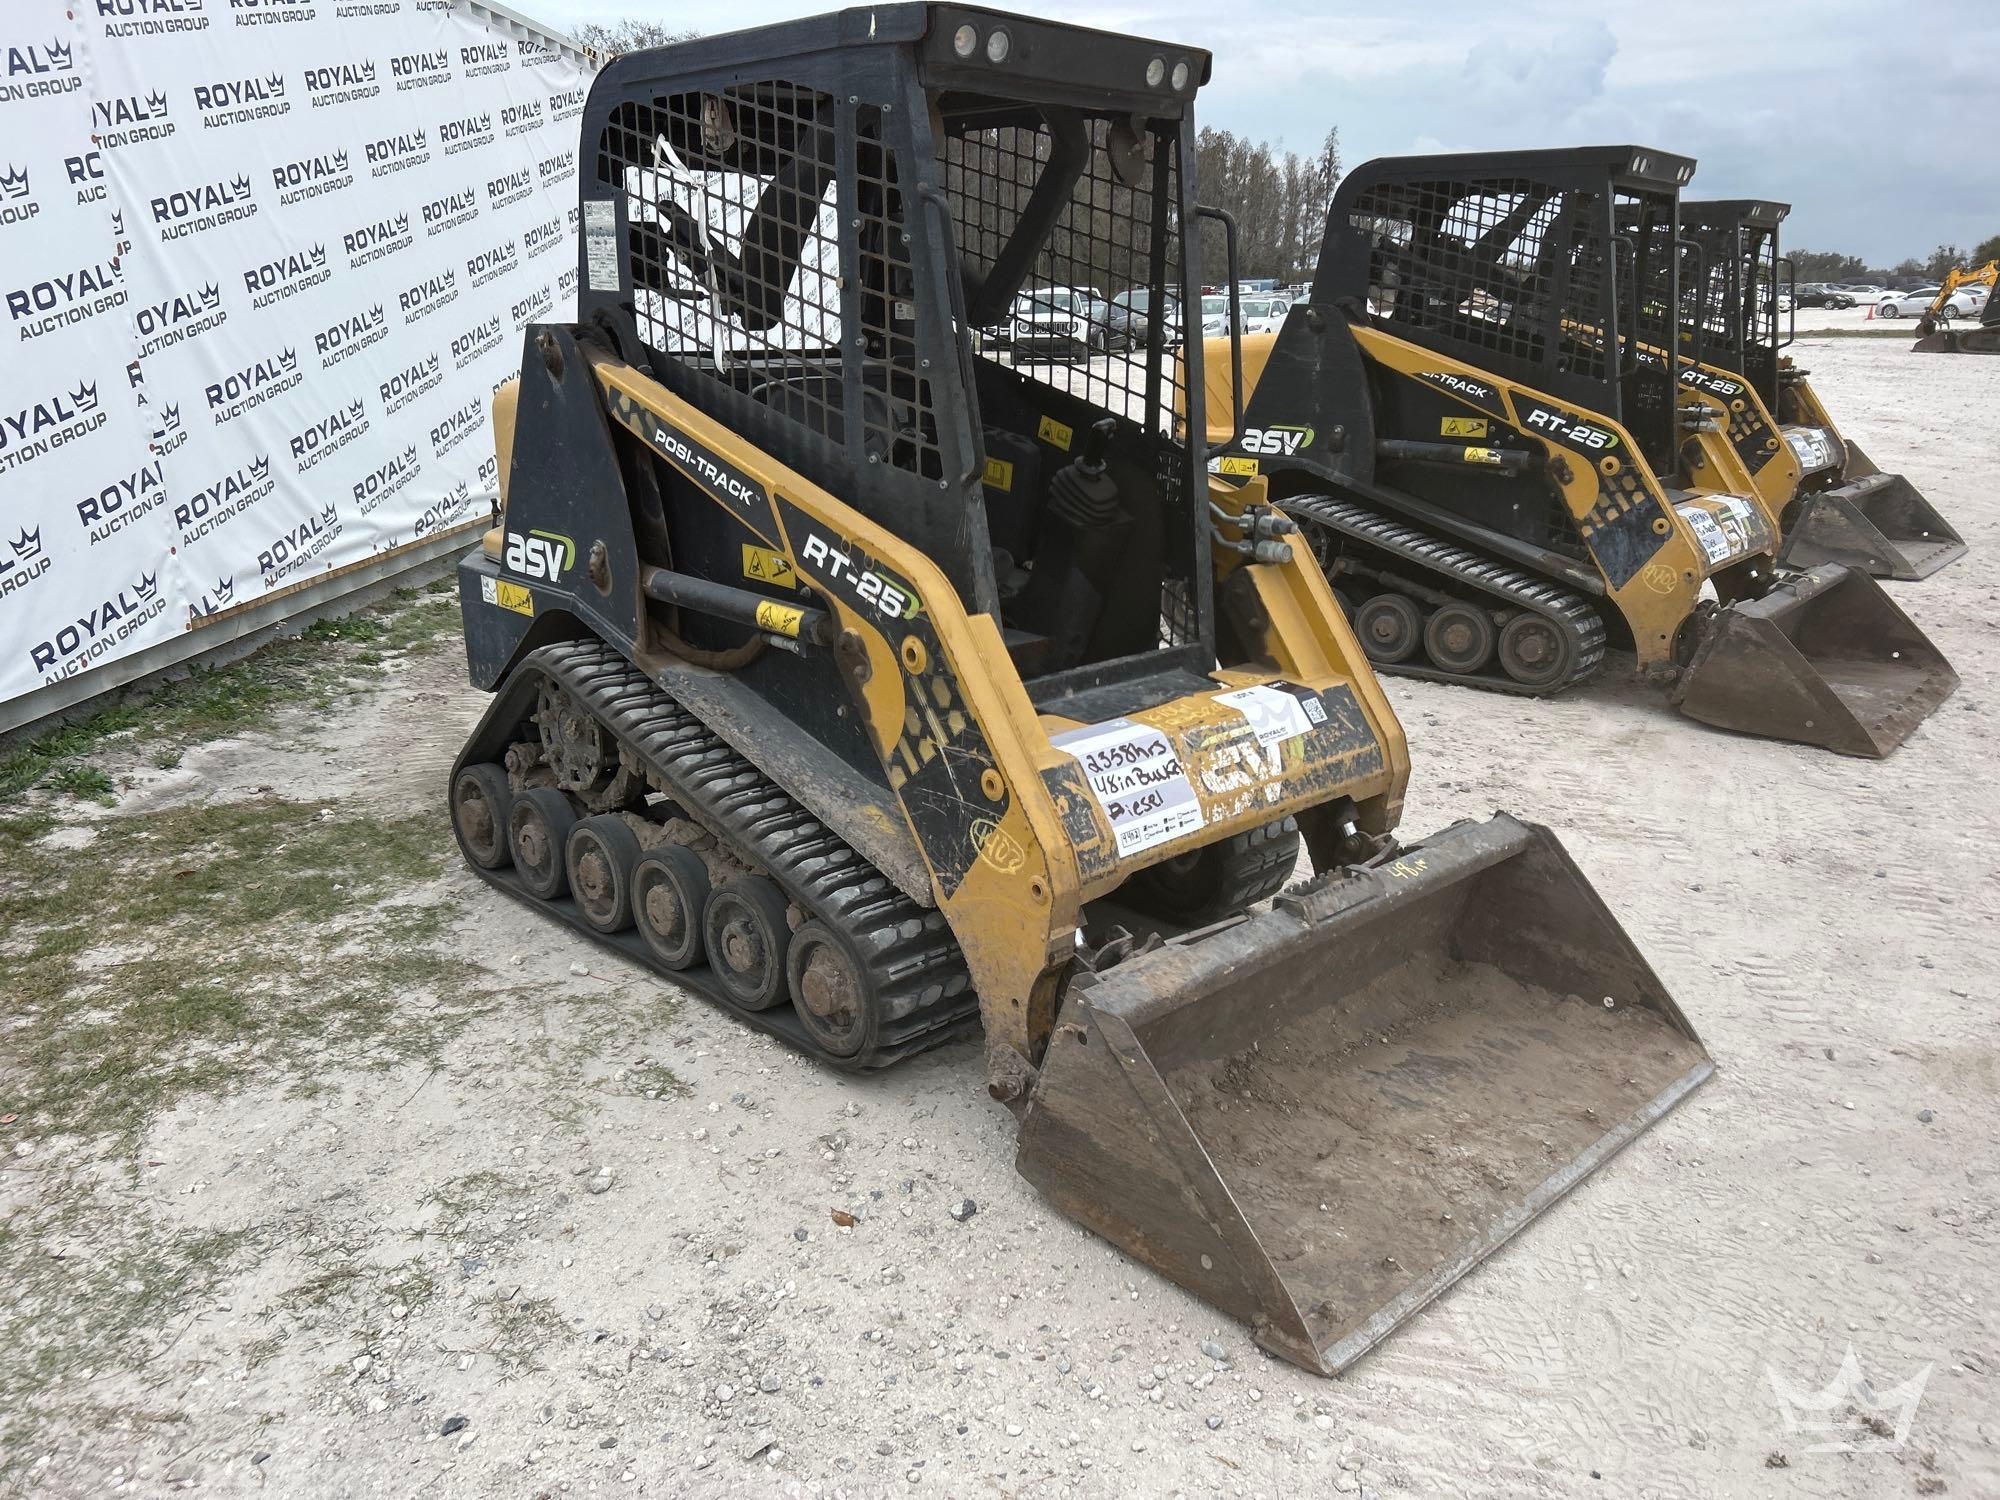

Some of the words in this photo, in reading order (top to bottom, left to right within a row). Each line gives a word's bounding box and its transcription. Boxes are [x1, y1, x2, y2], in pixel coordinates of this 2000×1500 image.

[235, 12, 282, 26] AUCTION
[282, 9, 316, 23] GROUP
[336, 5, 373, 18] AUCTION
[373, 1, 400, 15] GROUP
[105, 21, 164, 38] AUCTION
[166, 17, 210, 32] GROUP
[391, 52, 438, 77] ROYAL
[461, 43, 500, 65] ROYAL
[465, 64, 493, 78] AUCTION
[492, 62, 511, 74] GROUP
[26, 76, 82, 98] GROUP
[194, 78, 270, 110] ROYAL
[304, 64, 363, 91] ROYAL
[396, 75, 429, 92] AUCTION
[429, 72, 452, 86] GROUP
[312, 92, 351, 108] AUCTION
[351, 86, 380, 101] GROUP
[501, 100, 535, 126] ROYAL
[549, 91, 578, 111] ROYAL
[129, 123, 176, 143] GROUP
[204, 109, 255, 129] AUCTION
[255, 102, 291, 119] GROUP
[440, 117, 482, 143] ROYAL
[505, 124, 528, 138] AUCTION
[527, 119, 544, 132] GROUP
[365, 134, 416, 163] ROYAL
[444, 140, 474, 156] AUCTION
[473, 133, 495, 149] GROUP
[272, 155, 336, 190] ROYAL
[371, 160, 406, 179] AUCTION
[406, 152, 431, 168] GROUP
[538, 154, 567, 178] ROYAL
[150, 182, 234, 223] ROYAL
[280, 183, 323, 207] AUCTION
[323, 175, 354, 193] GROUP
[487, 172, 523, 199] ROYAL
[492, 194, 517, 212] AUCTION
[516, 186, 533, 201] GROUP
[161, 215, 217, 243] AUCTION
[217, 203, 258, 225] GROUP
[422, 193, 466, 224] ROYAL
[427, 217, 457, 238] AUCTION
[456, 208, 479, 226] GROUP
[343, 219, 398, 255] ROYAL
[524, 221, 555, 248] ROYAL
[527, 242, 548, 259] AUCTION
[547, 233, 564, 247] GROUP
[350, 247, 386, 270] AUCTION
[386, 235, 413, 255] GROUP
[467, 246, 507, 277] ROYAL
[244, 252, 312, 293] ROYAL
[253, 286, 298, 311] AUCTION
[299, 269, 331, 292] GROUP
[472, 269, 499, 290] AUCTION
[498, 259, 519, 277] GROUP
[6, 264, 113, 320] ROYAL
[399, 276, 446, 312] ROYAL
[405, 302, 436, 326] AUCTION
[436, 289, 459, 309] GROUP
[511, 291, 544, 321] ROYAL
[20, 303, 93, 341] AUCTION
[186, 311, 227, 338] GROUP
[314, 312, 373, 355] ROYAL
[322, 342, 361, 370] AUCTION
[360, 326, 389, 349] GROUP
[451, 322, 492, 358] ROYAL
[455, 347, 484, 371] AUCTION
[483, 334, 504, 354] GROUP
[205, 358, 282, 409] ROYAL
[215, 391, 266, 426] AUCTION
[266, 372, 303, 400] GROUP
[380, 361, 429, 403] ROYAL
[386, 388, 419, 417] AUCTION
[418, 372, 443, 395] GROUP
[1681, 370, 1737, 395] RT-25
[50, 411, 107, 449] GROUP
[290, 409, 352, 459] ROYAL
[430, 406, 473, 447] ROYAL
[435, 433, 464, 460] AUCTION
[464, 415, 485, 437] GROUP
[1527, 409, 1608, 449] RT-25
[298, 440, 339, 474] AUCTION
[339, 420, 370, 447] GROUP
[353, 456, 407, 504] ROYAL
[654, 428, 753, 507] POSI-TRACK
[174, 469, 253, 531] ROYAL
[360, 484, 395, 518] AUCTION
[395, 464, 421, 490] GROUP
[90, 498, 152, 546] AUCTION
[183, 504, 237, 548] AUCTION
[236, 480, 275, 512] GROUP
[414, 492, 460, 537] ROYAL
[449, 499, 472, 523] GROUP
[257, 516, 323, 575] ROYAL
[264, 549, 312, 590] AUCTION
[312, 524, 343, 555] GROUP
[803, 533, 905, 619] RT-25
[30, 592, 139, 674] ROYAL
[117, 597, 167, 641] GROUP
